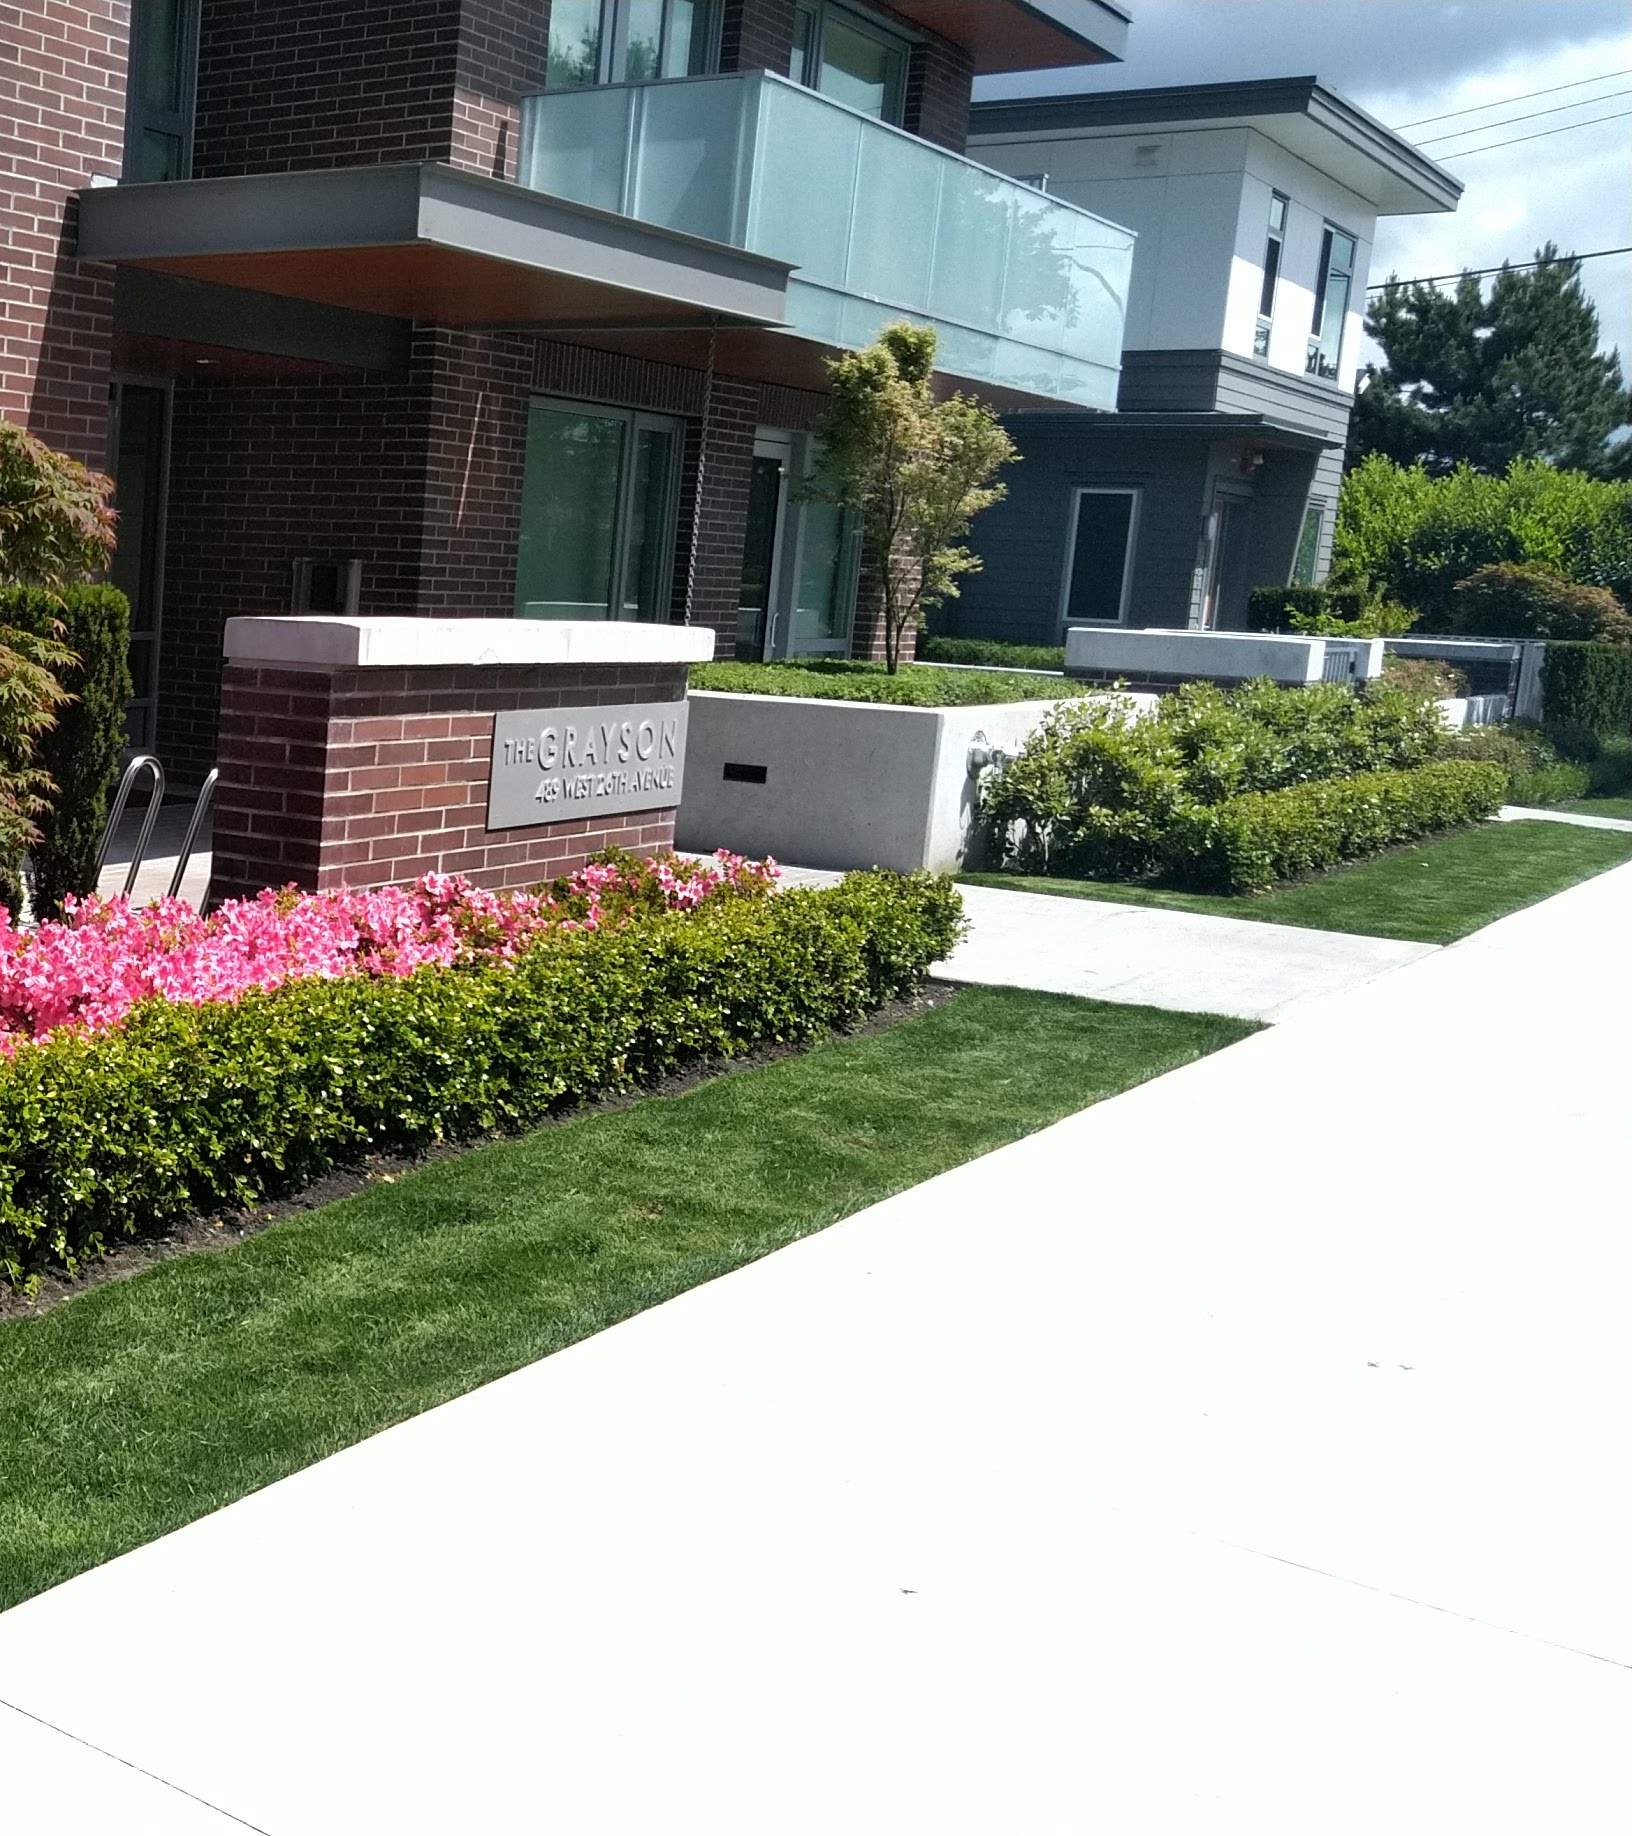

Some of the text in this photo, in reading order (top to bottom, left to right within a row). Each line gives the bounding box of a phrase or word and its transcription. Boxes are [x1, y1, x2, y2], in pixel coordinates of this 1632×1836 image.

[504, 719, 678, 771] THE GRAYSON
[535, 765, 675, 804] 489 WEST 26TH AVENUE
